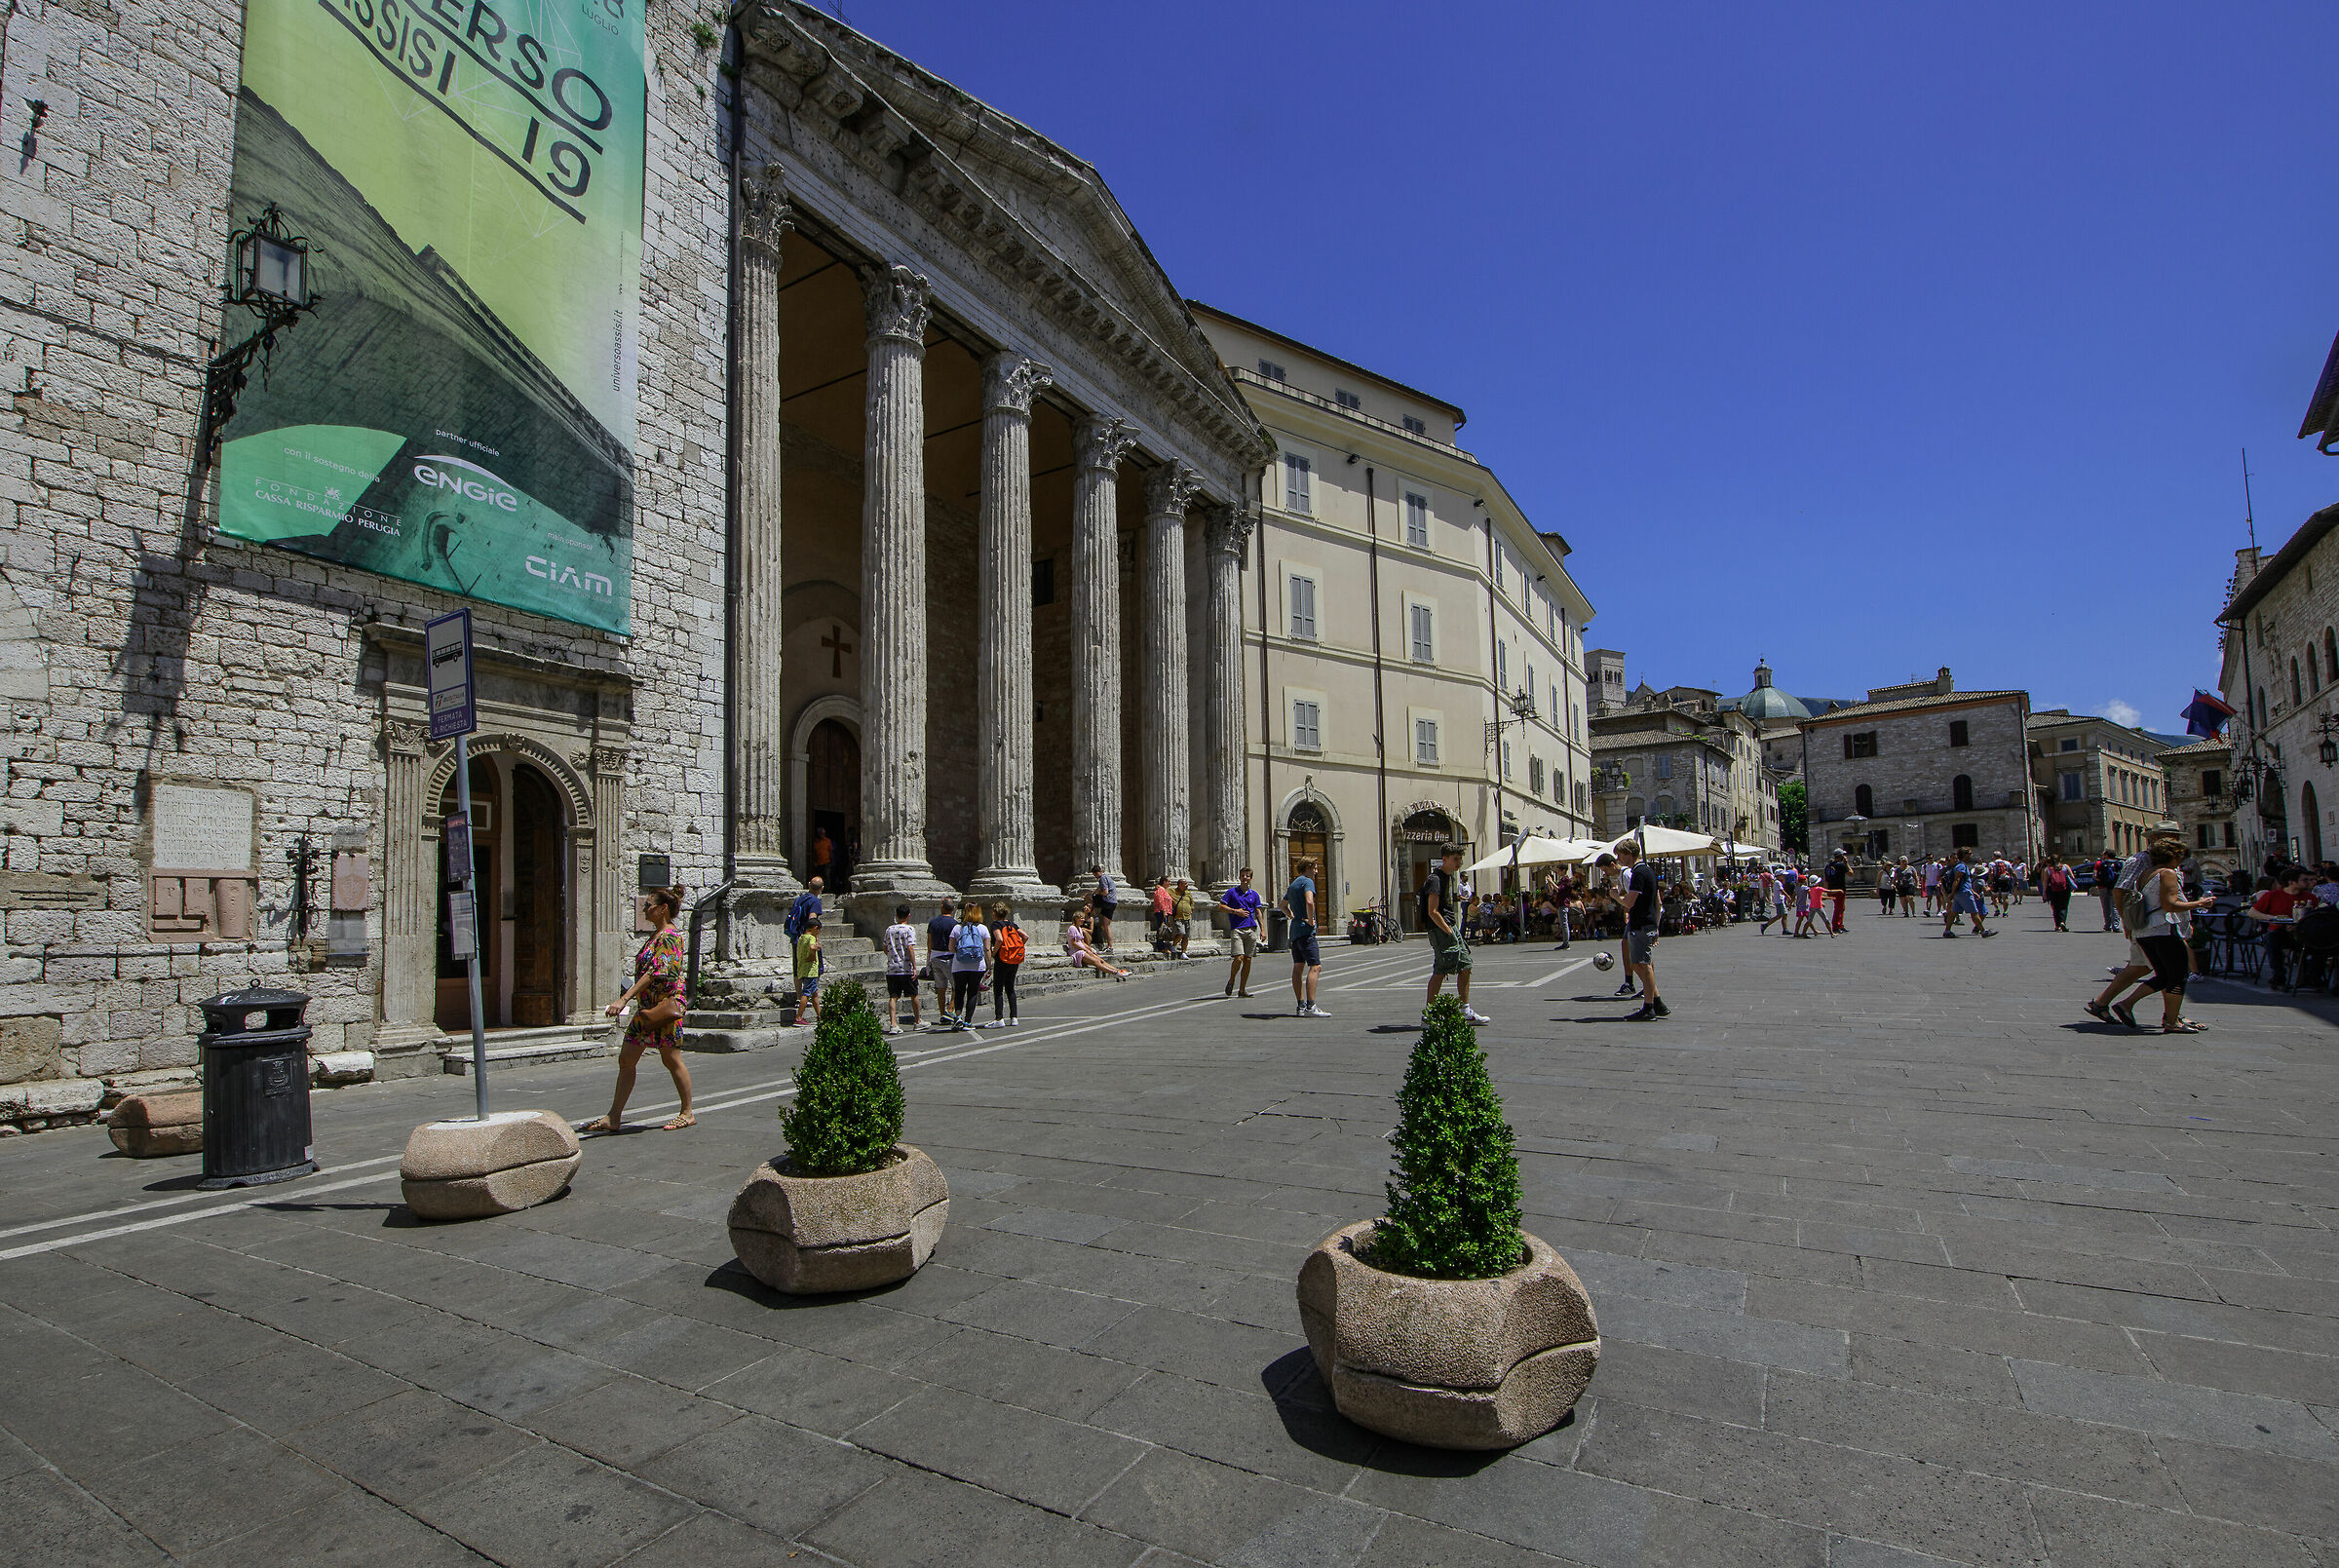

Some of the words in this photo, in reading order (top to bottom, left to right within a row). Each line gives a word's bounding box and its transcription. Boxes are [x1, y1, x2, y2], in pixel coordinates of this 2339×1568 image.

[582, 3, 619, 36] LUGLIO
[344, 0, 456, 96] SSISI
[611, 309, 624, 392] universoassisi.it
[436, 429, 468, 444] partner
[469, 440, 500, 457] ufficiale
[284, 446, 302, 459] con
[305, 451, 311, 461] il
[313, 455, 356, 476] sostegno
[358, 469, 381, 483] della
[255, 478, 403, 527] FONDAZIONE
[255, 489, 291, 507] CASSA
[295, 500, 355, 524] RISPARMIO
[358, 517, 402, 537] PERUGIA
[547, 532, 564, 543] main
[565, 537, 594, 552] sponsor
[438, 710, 463, 724] FERMATA
[441, 719, 468, 732] RICHIESTA
[1403, 829, 1433, 841] izzeria
[1435, 830, 1450, 842] One
